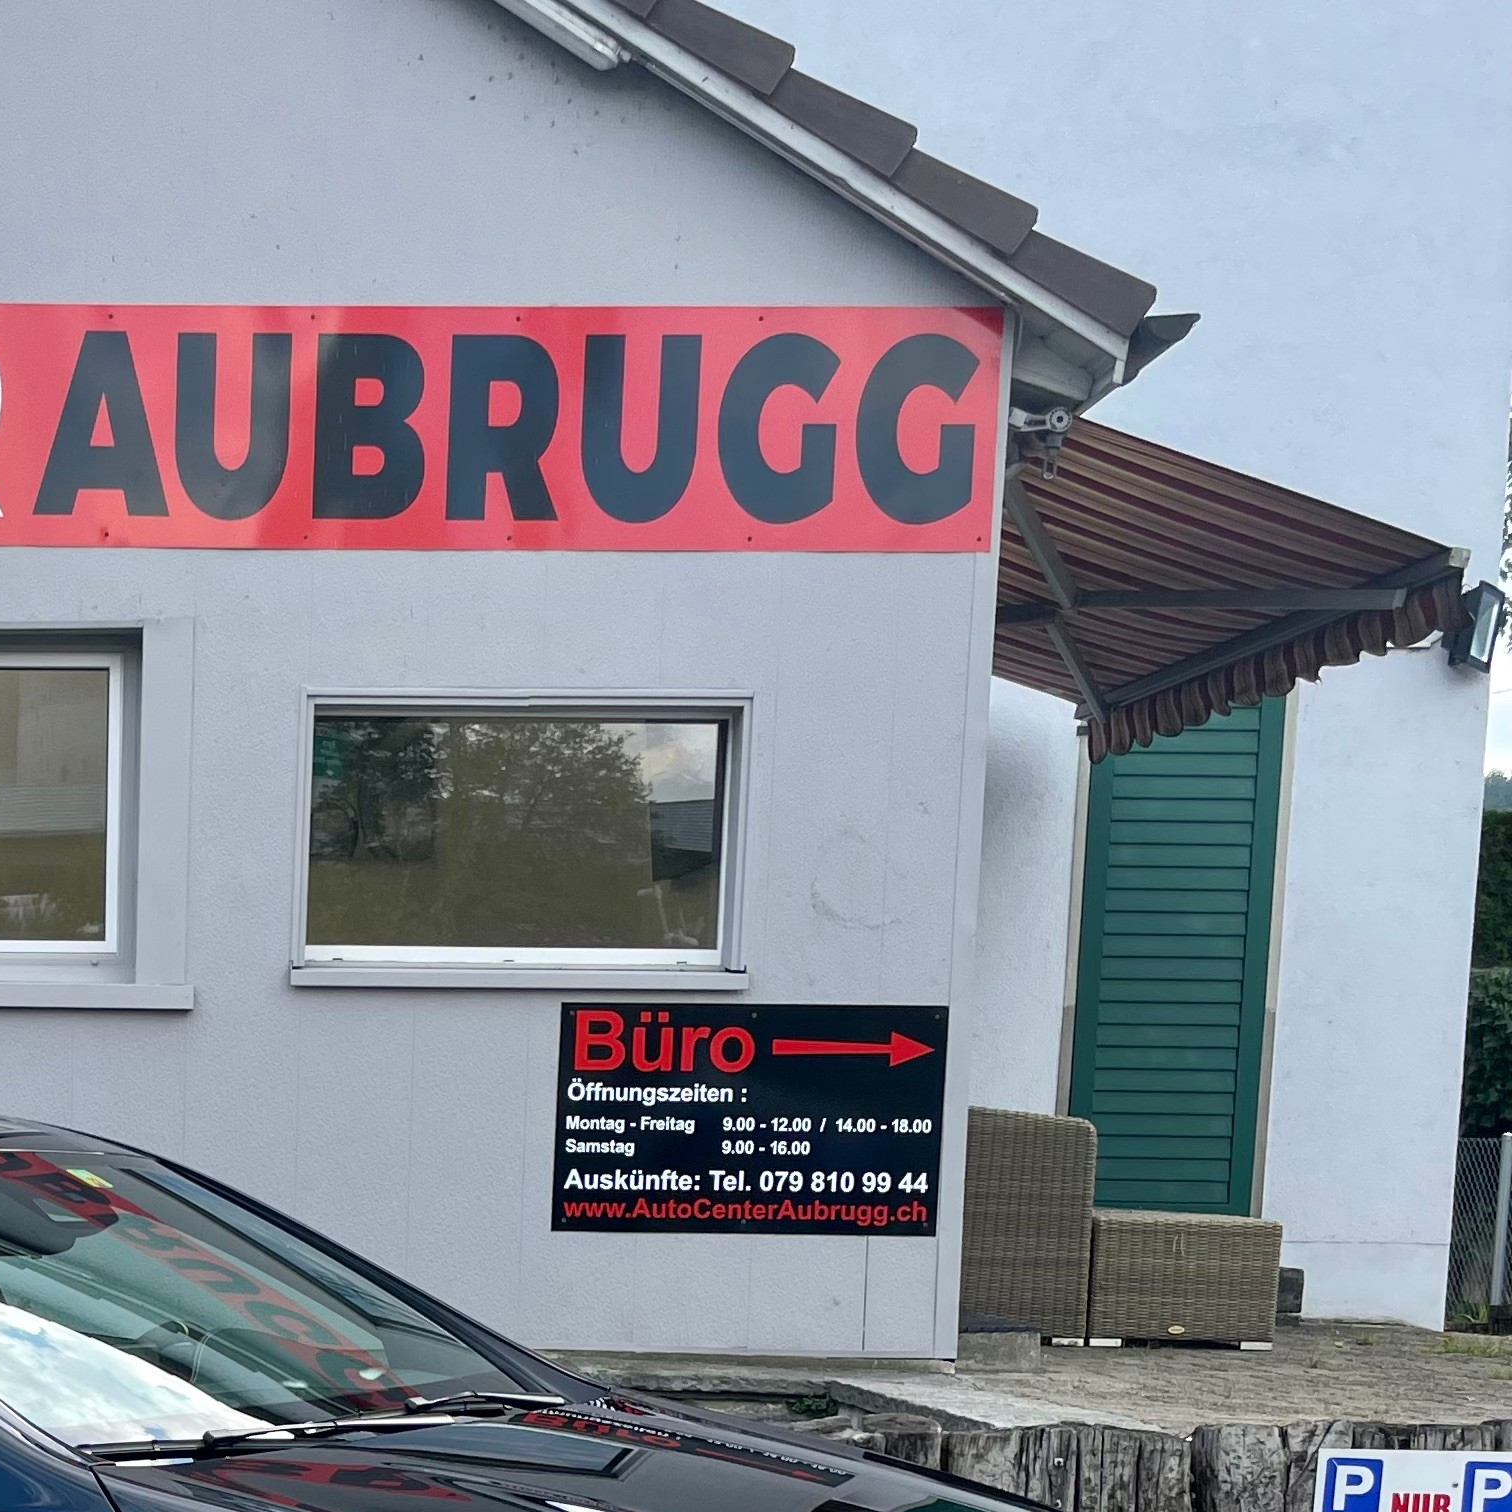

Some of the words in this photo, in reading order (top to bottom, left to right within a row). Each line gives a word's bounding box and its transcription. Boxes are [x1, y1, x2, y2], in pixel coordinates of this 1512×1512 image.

[32, 330, 982, 525] AUBRUGG
[573, 1009, 756, 1073] Büro
[567, 1078, 734, 1106] Öffnungszeiten
[565, 1115, 626, 1134] Montag
[640, 1116, 696, 1134] Freitag
[722, 1117, 756, 1132] 9.00
[770, 1117, 812, 1133] 12.00
[835, 1118, 876, 1134] 14.00
[891, 1118, 932, 1134] 18.00
[565, 1139, 635, 1157] Samstag
[721, 1140, 756, 1155] 9.00
[770, 1140, 811, 1156] 16.00
[563, 1169, 701, 1191] Auskünfte:
[708, 1170, 752, 1192] Tel.
[759, 1171, 804, 1193] 079
[811, 1171, 855, 1193] 810
[861, 1172, 892, 1193] 99
[898, 1172, 929, 1194] 44
[563, 1198, 928, 1227] www.AutoCenterAubrugg.ch
[1332, 1465, 1375, 1511] P
